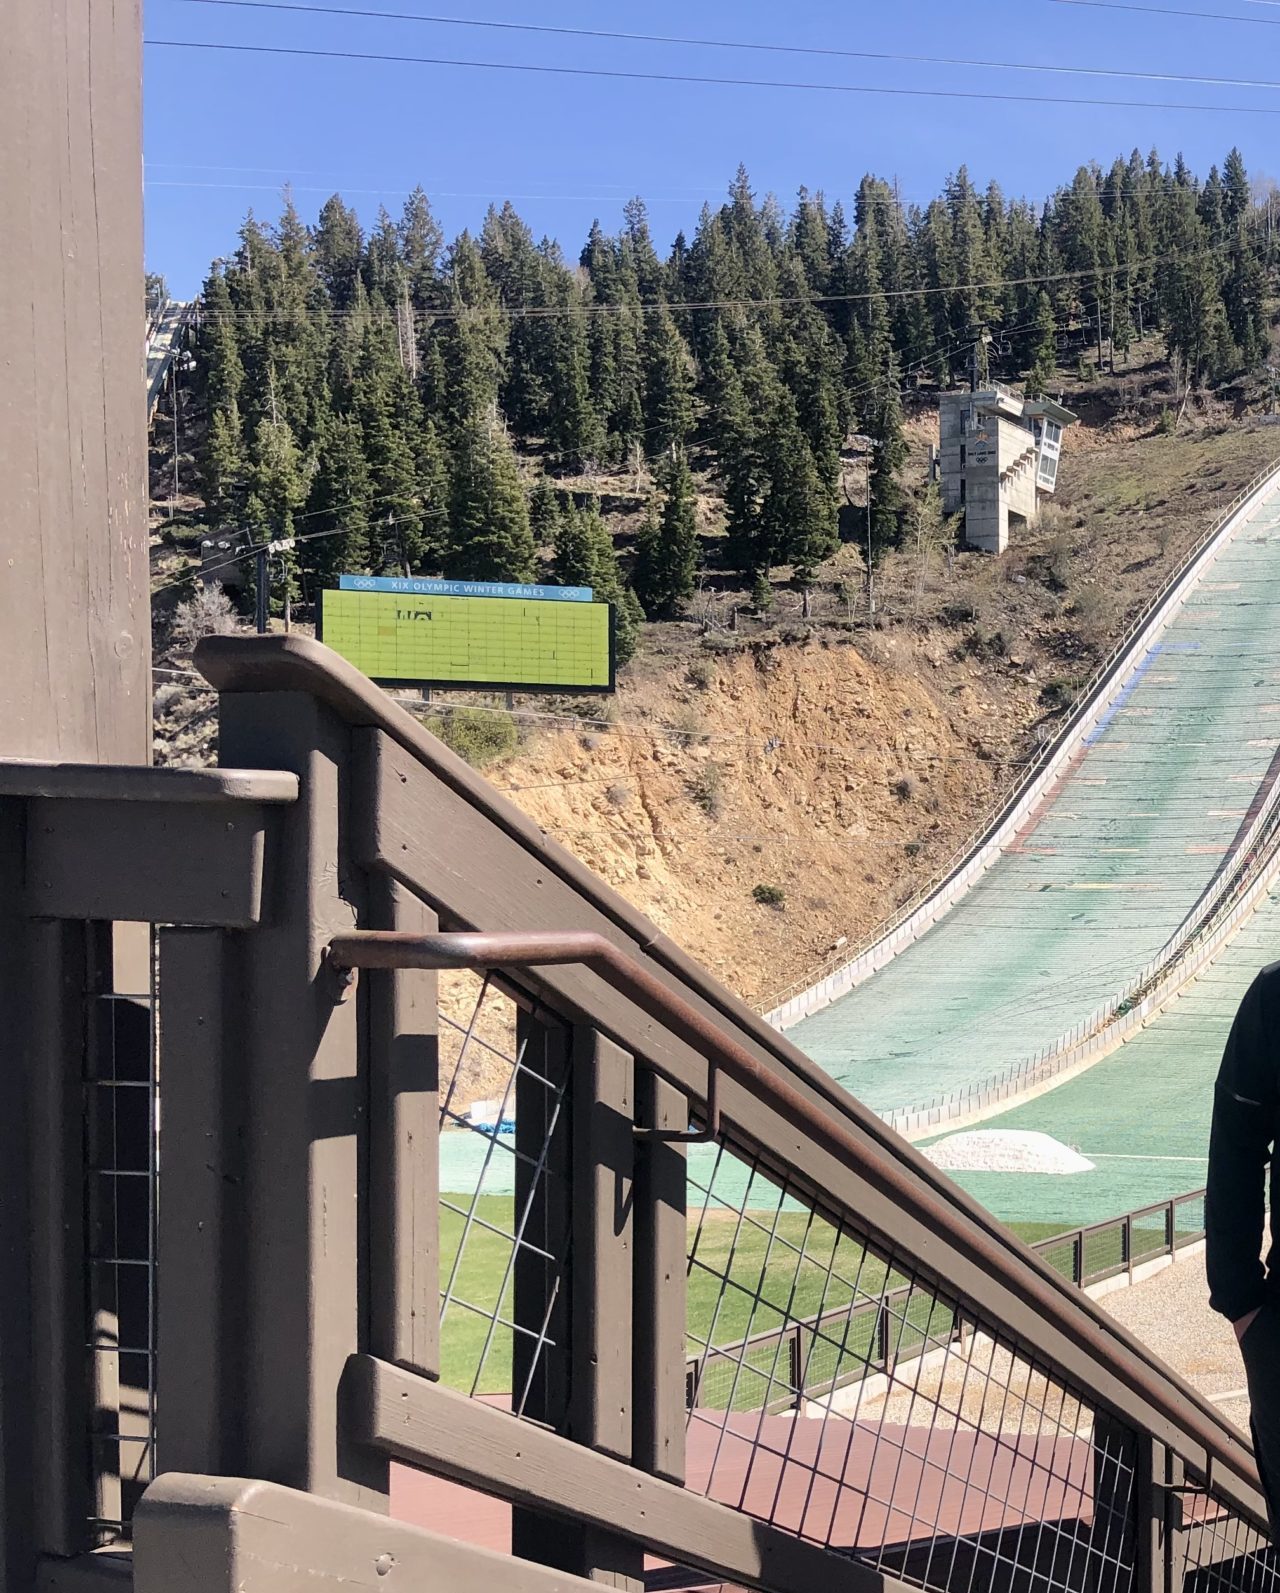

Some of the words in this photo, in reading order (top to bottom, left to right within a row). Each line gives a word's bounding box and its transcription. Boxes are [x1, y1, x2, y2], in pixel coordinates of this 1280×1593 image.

[391, 581, 409, 590] XIX
[413, 582, 460, 593] OLYMPIC
[464, 584, 504, 595] WINTER
[508, 587, 545, 597] GAMES
